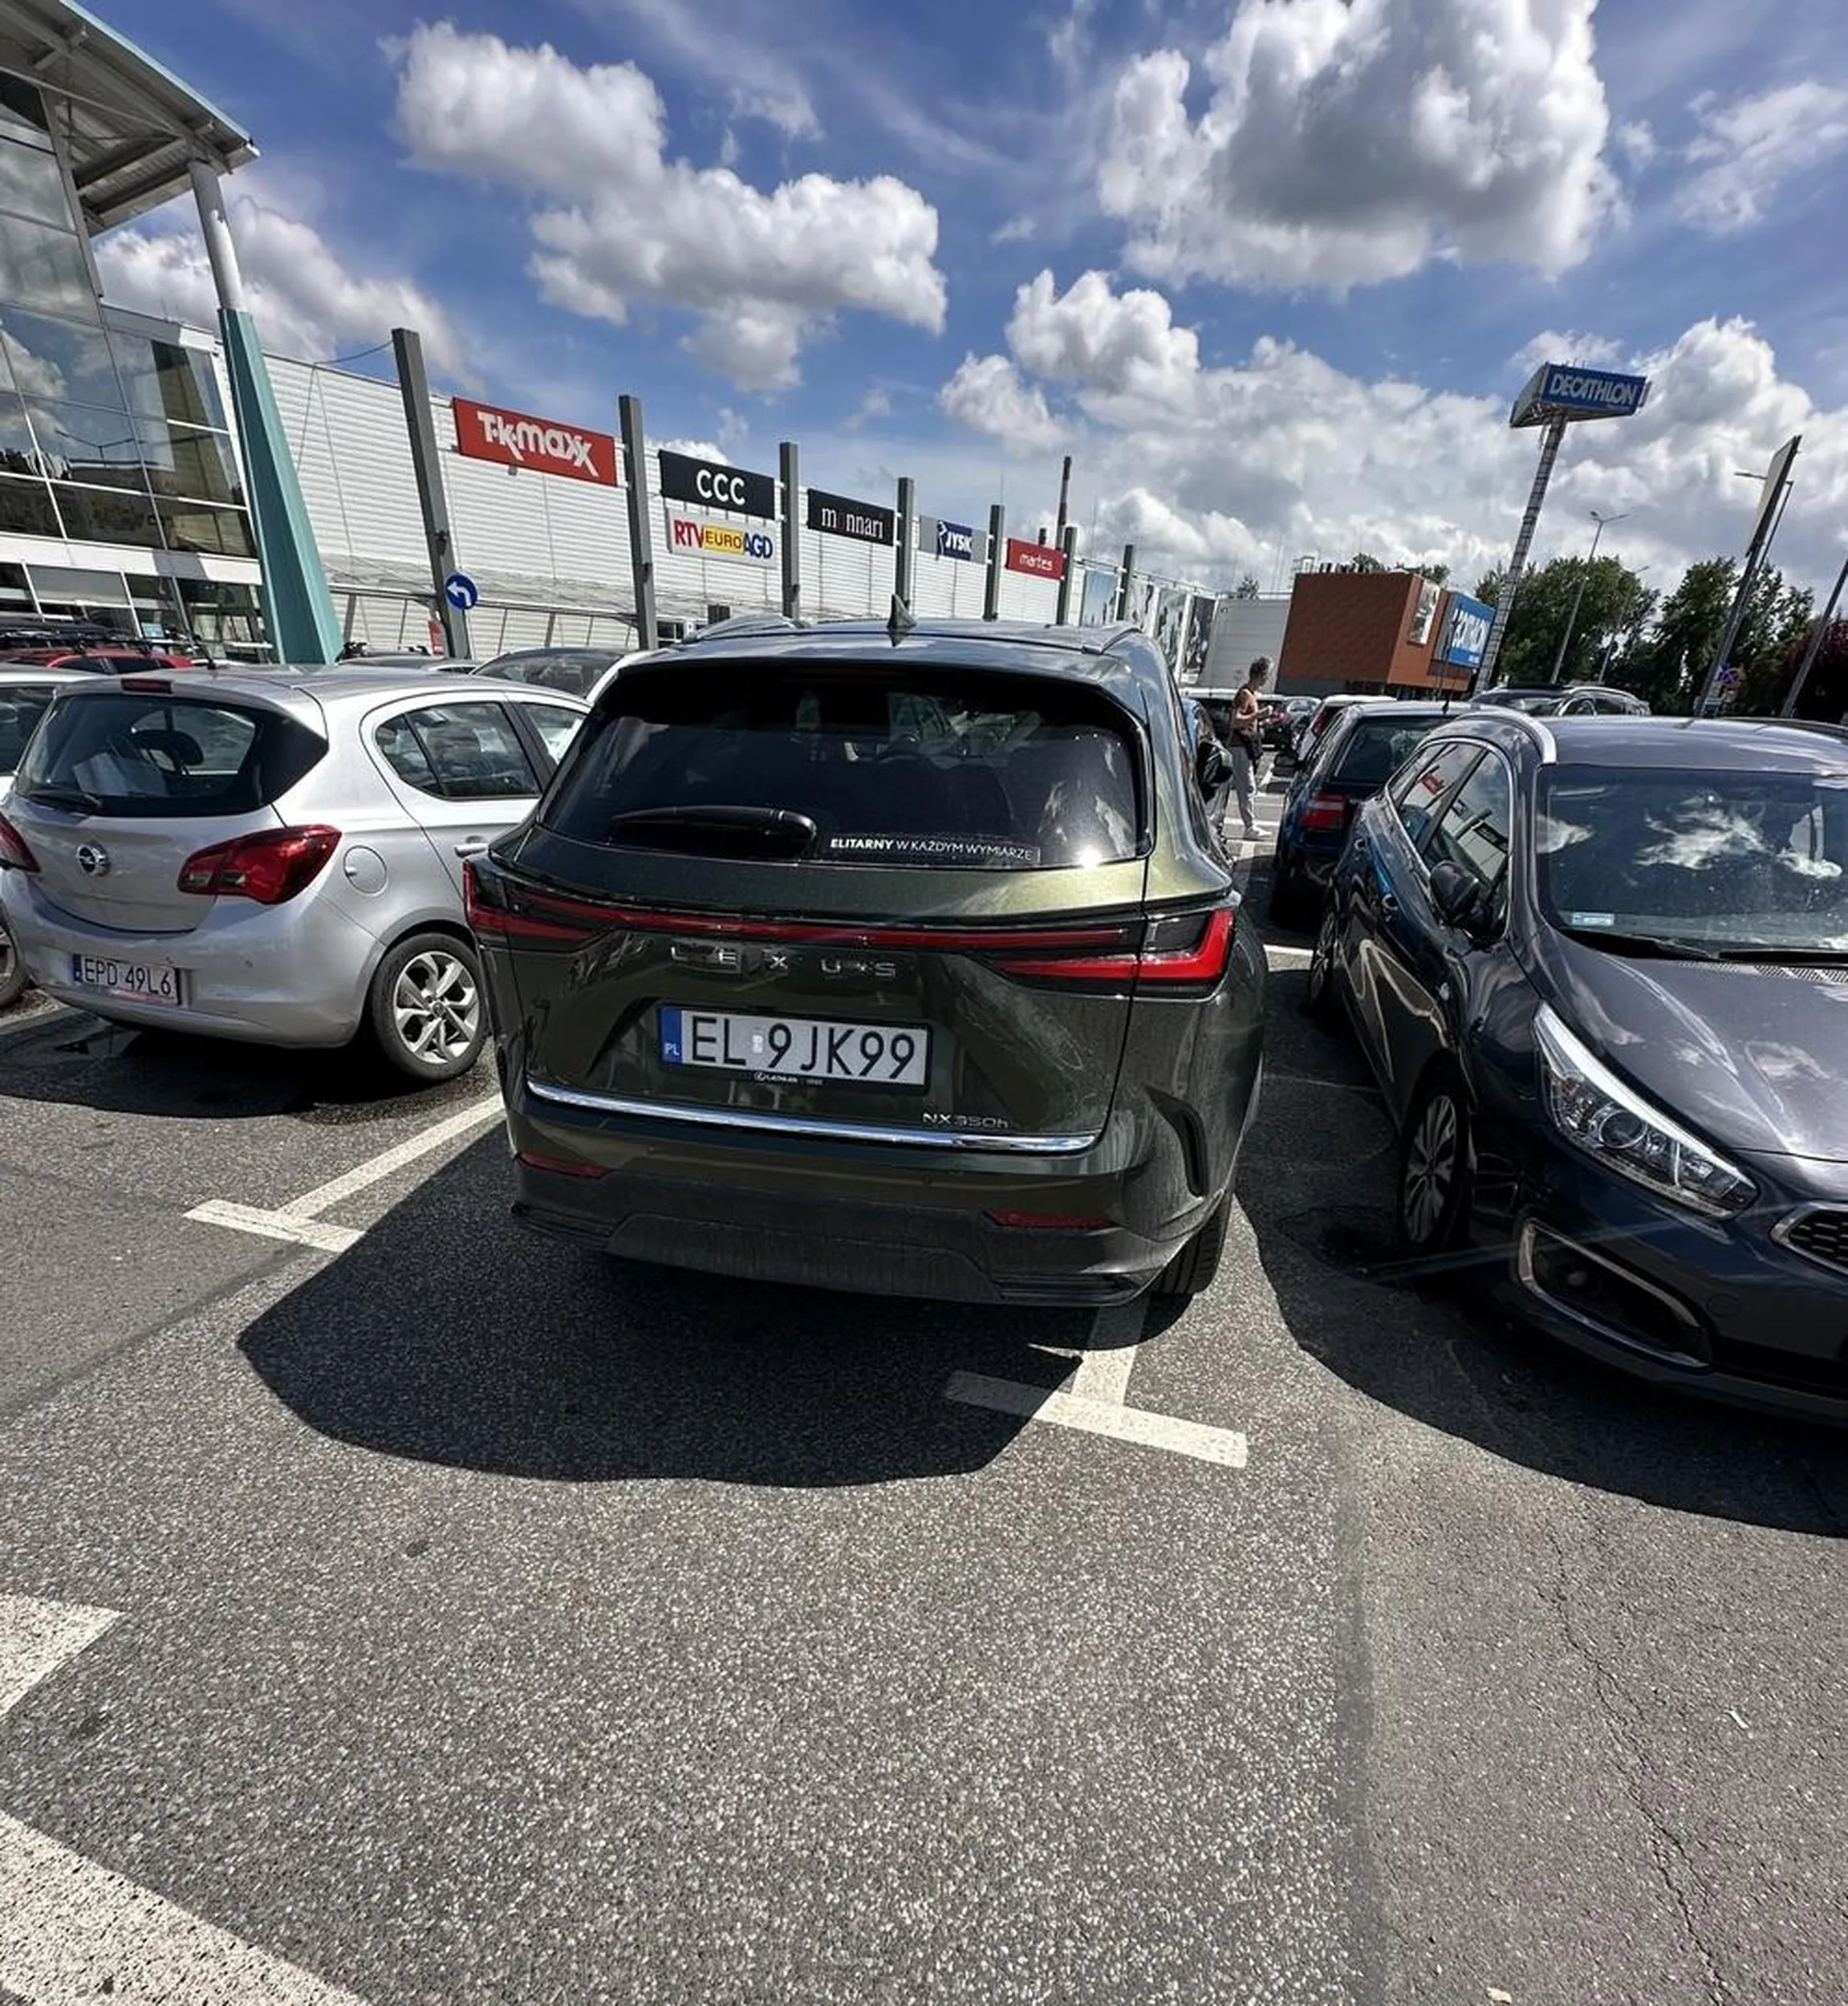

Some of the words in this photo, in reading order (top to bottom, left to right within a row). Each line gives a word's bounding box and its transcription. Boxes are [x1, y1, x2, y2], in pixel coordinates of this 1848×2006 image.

[1549, 373, 1638, 404] DECATHLON
[696, 469, 746, 506] CCC
[674, 519, 705, 549] RTV
[705, 530, 742, 549] EURO
[743, 532, 774, 558] AGD
[945, 530, 972, 553] JYSK
[830, 839, 894, 851] ELITARNY
[896, 841, 910, 851] W
[965, 844, 1034, 861] WYMIARZE
[84, 957, 118, 986] EPD
[125, 965, 172, 995] 49L6
[670, 946, 896, 977] LEXUS
[664, 1042, 680, 1056] PL
[692, 1015, 746, 1066] EL
[767, 1022, 916, 1080] 9JK99
[923, 1112, 951, 1125] NX
